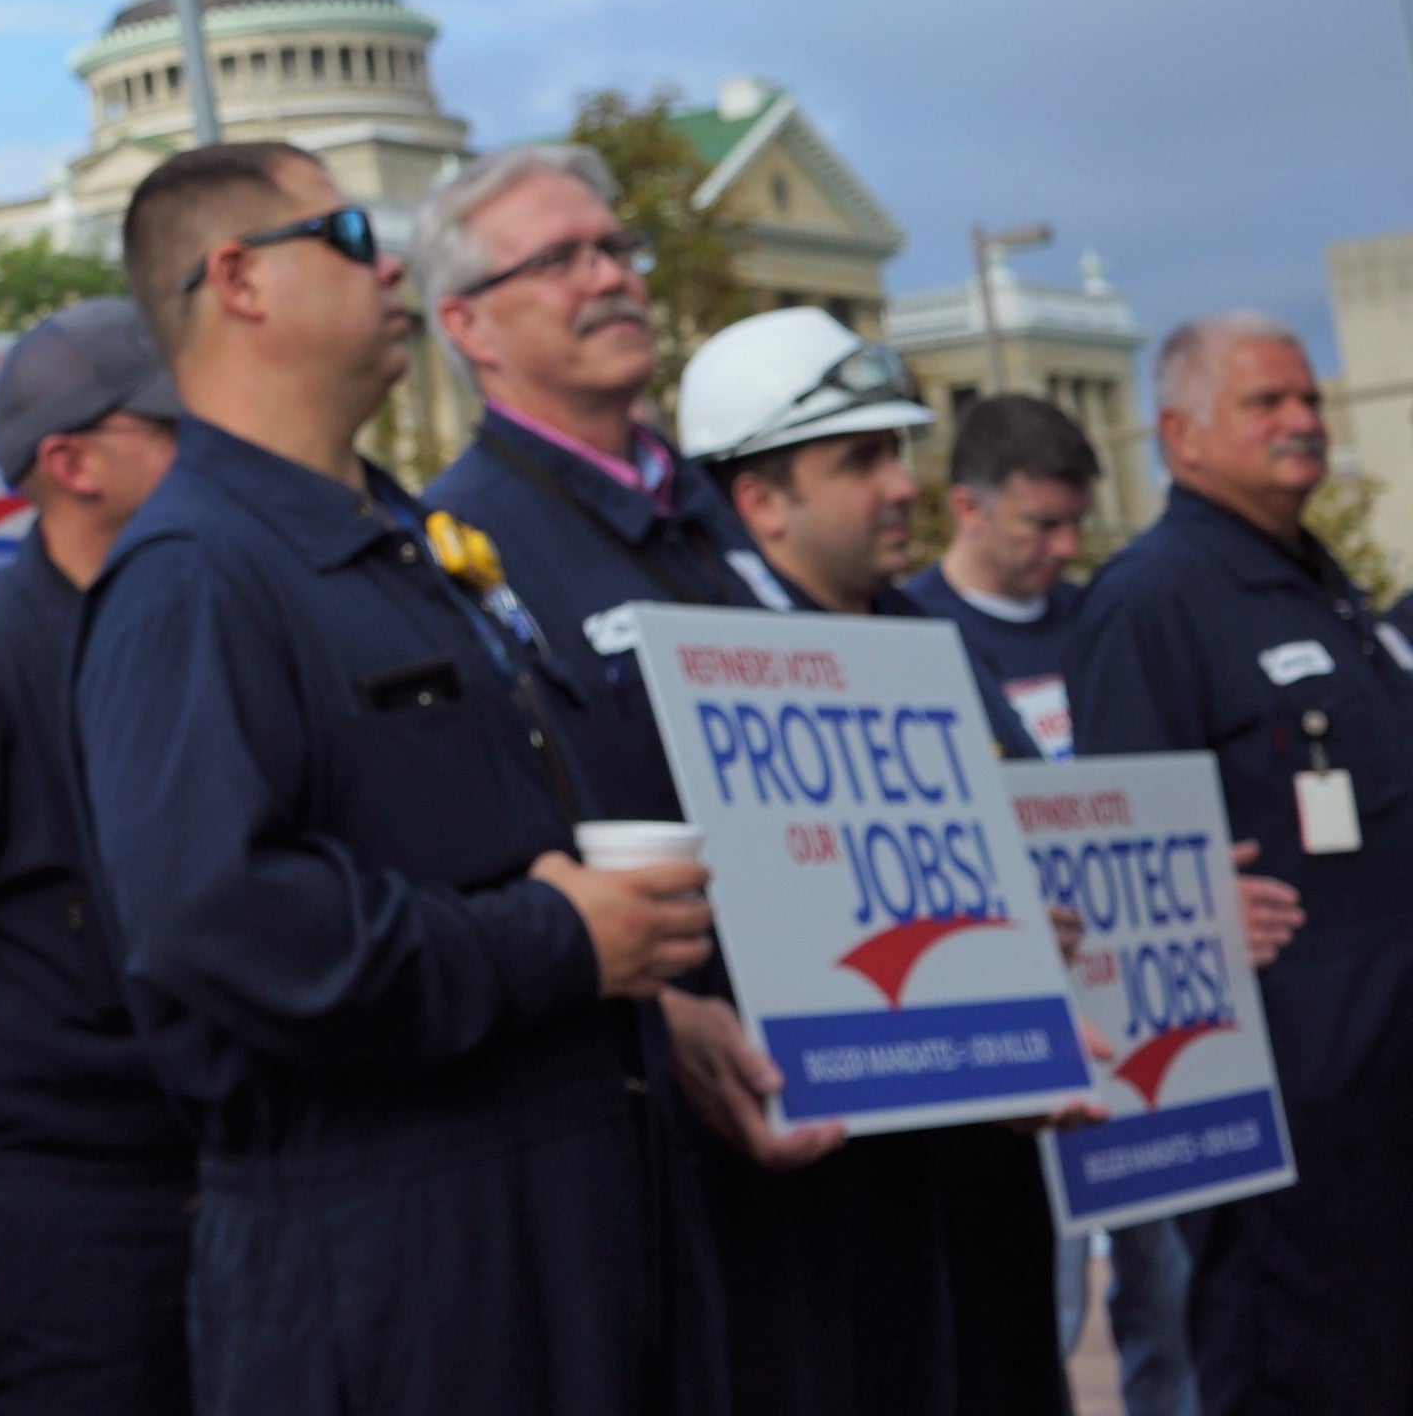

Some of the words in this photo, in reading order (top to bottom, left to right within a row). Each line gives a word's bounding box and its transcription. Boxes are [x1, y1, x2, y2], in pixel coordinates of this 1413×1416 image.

[695, 698, 975, 806] PROTECT
[841, 818, 1010, 927] JOBS!
[1119, 937, 1238, 1039] JOBS!
